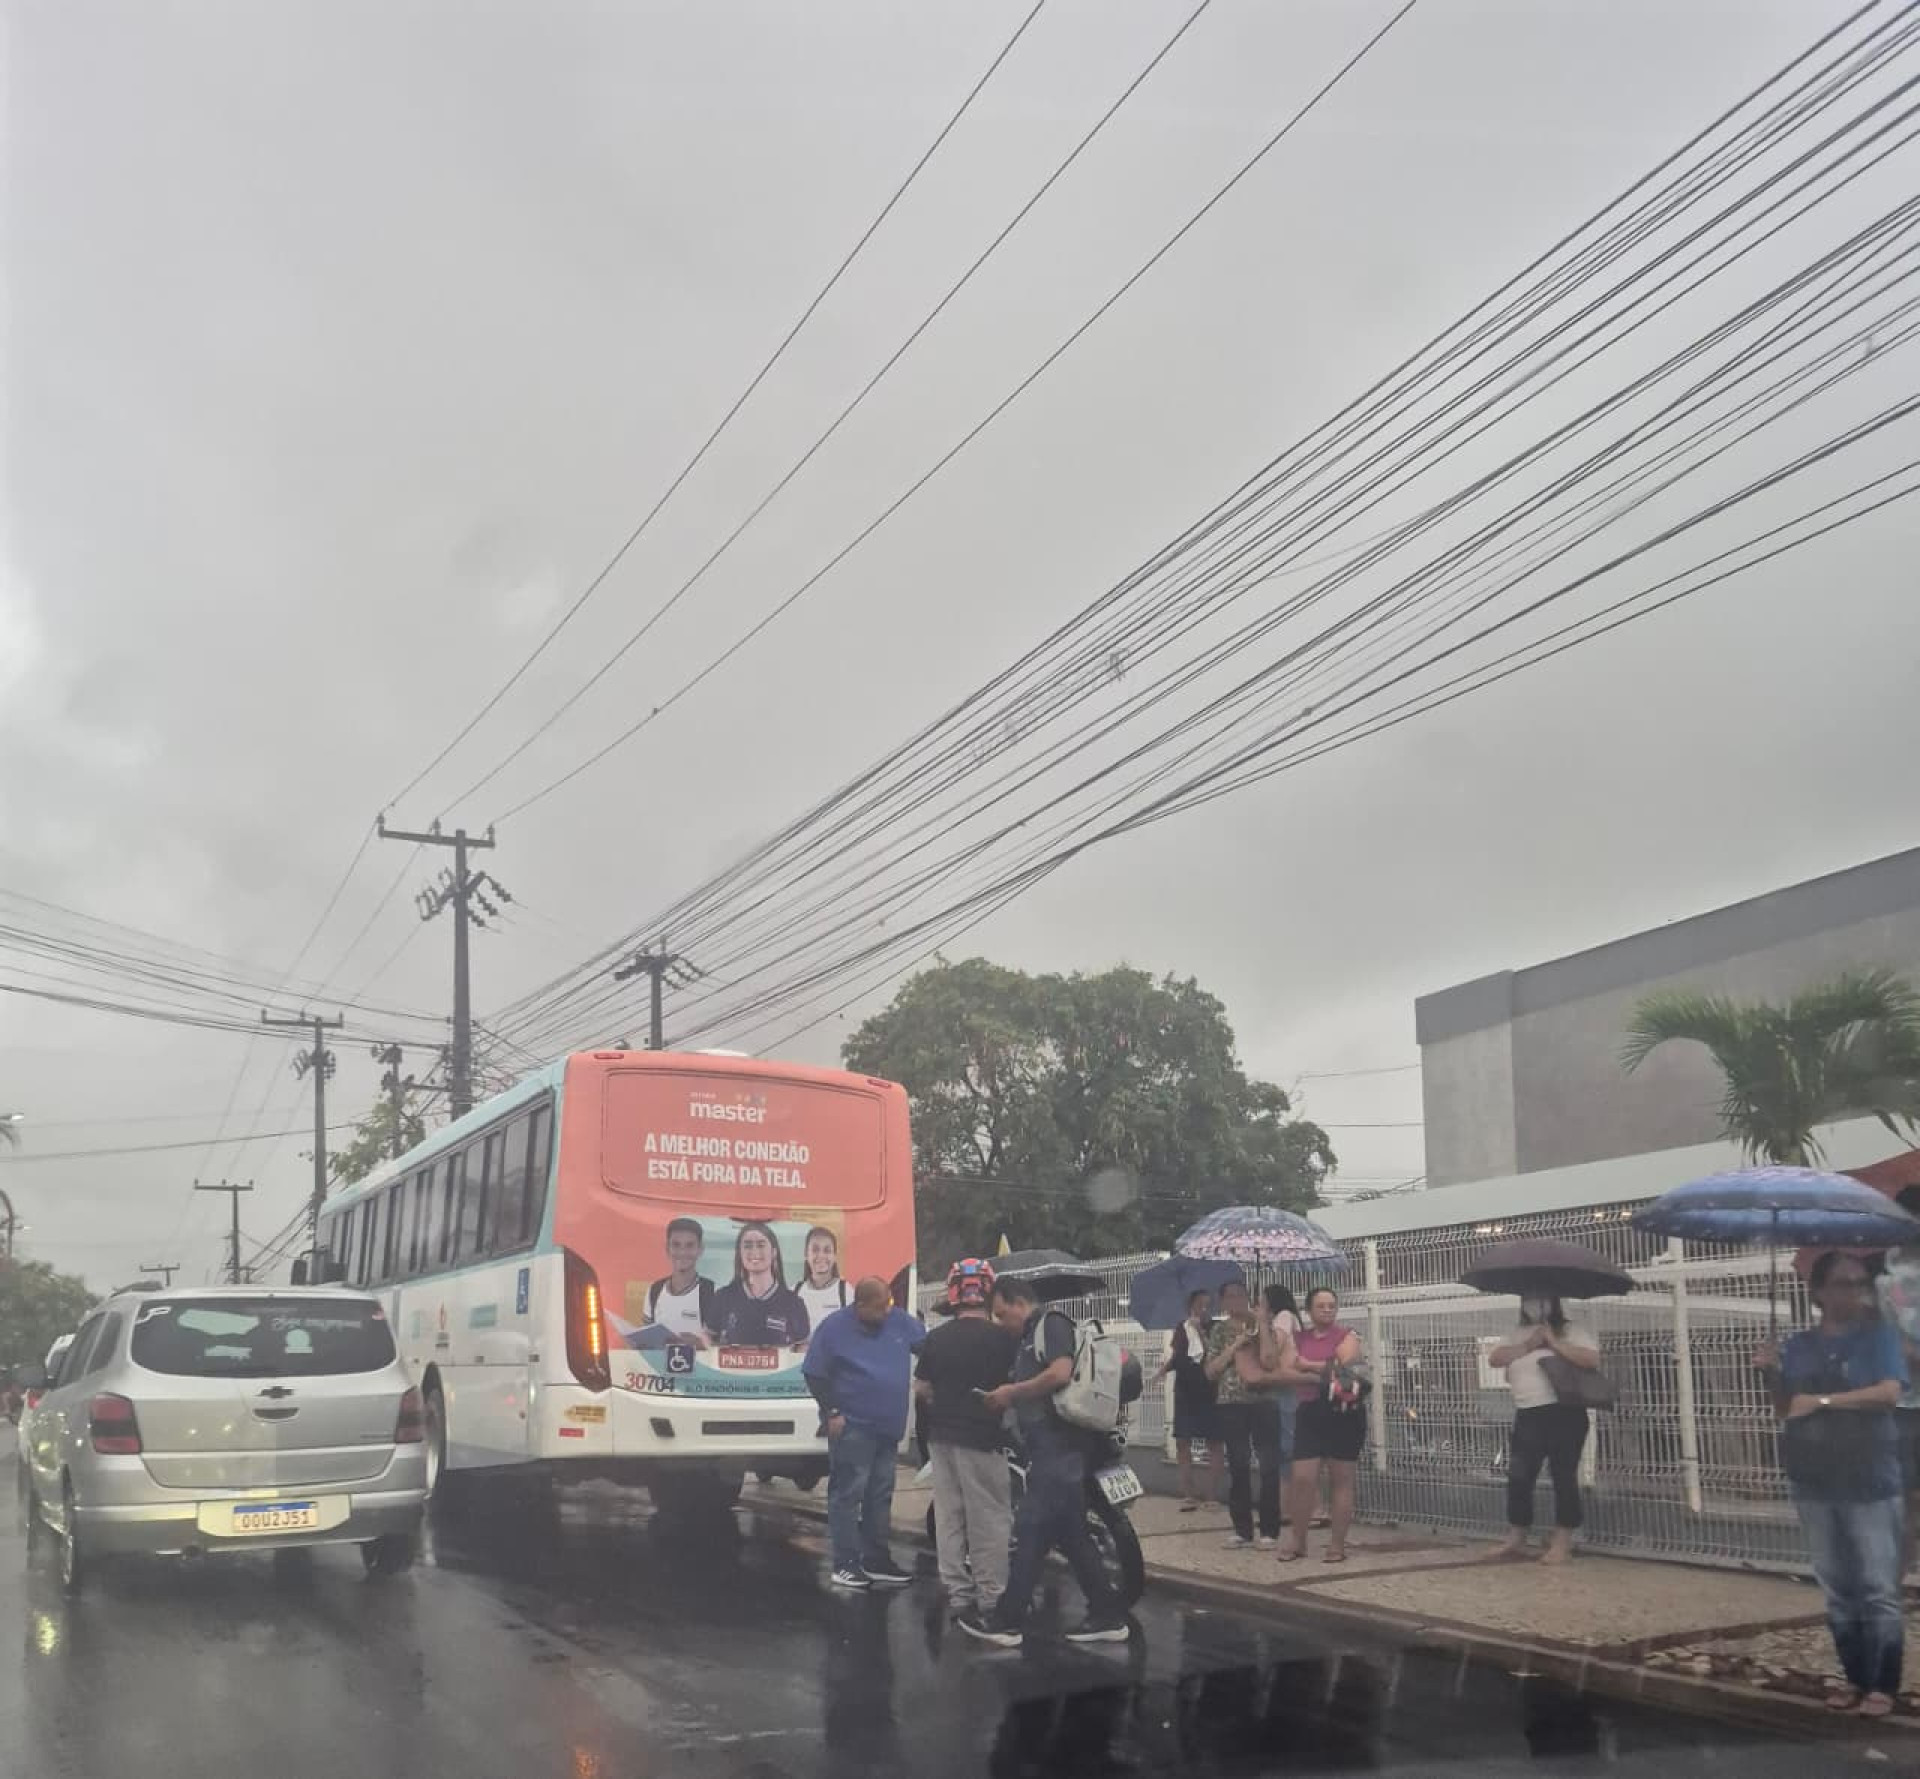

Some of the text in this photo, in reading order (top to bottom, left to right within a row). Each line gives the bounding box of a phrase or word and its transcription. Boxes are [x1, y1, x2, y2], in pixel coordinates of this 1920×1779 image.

[690, 1101, 767, 1123] master
[645, 1133, 810, 1164] A MELHOR CONEXÃO
[648, 1156, 807, 1189] ESTÁ FORA DA TELA.
[625, 1371, 675, 1393] 30704
